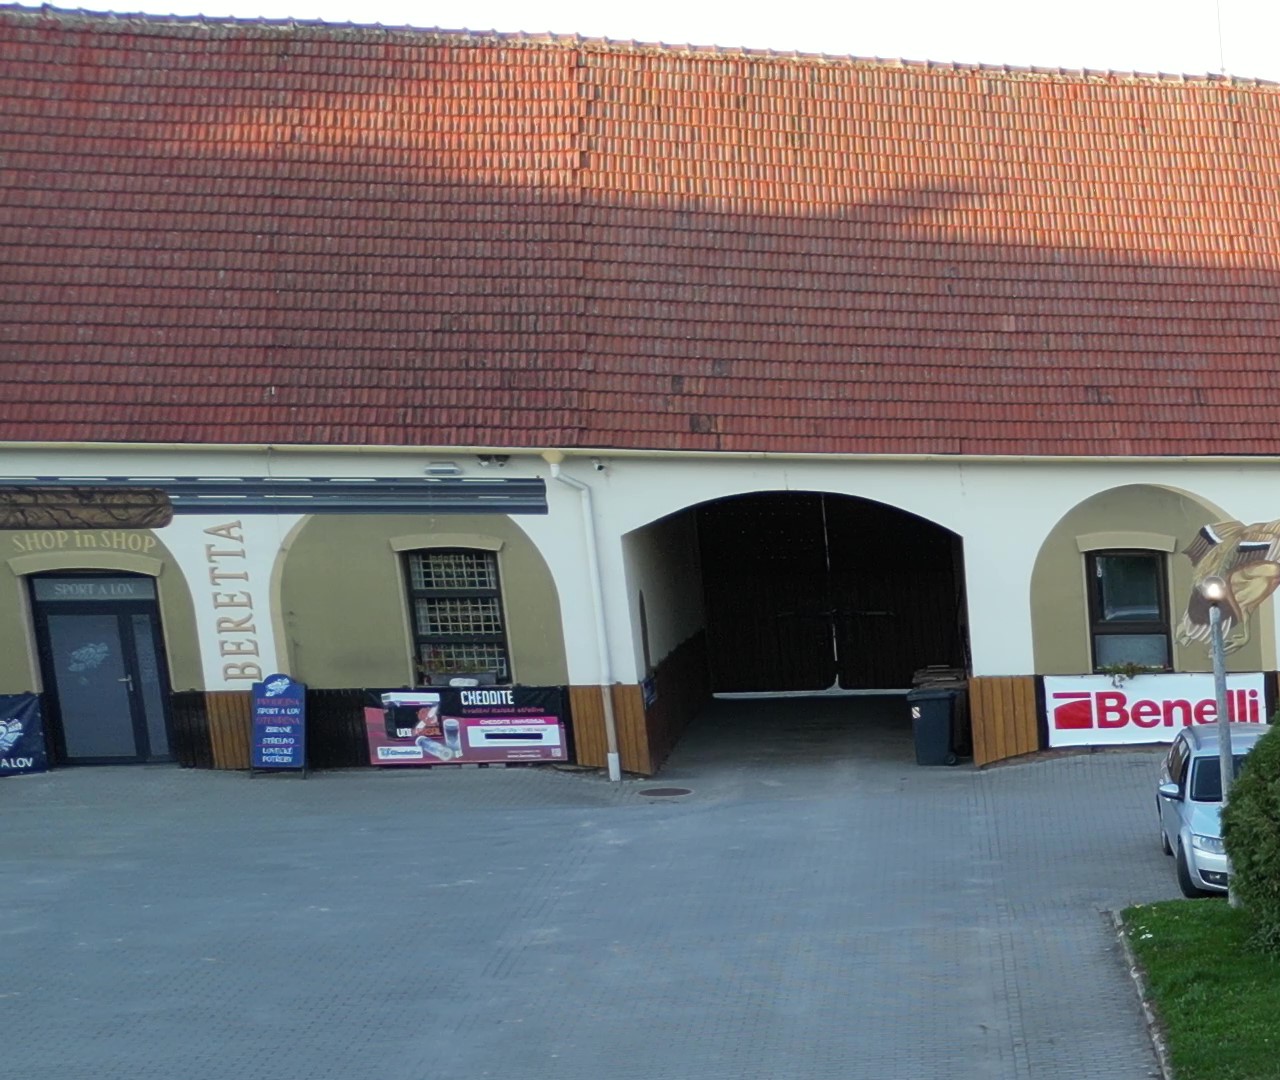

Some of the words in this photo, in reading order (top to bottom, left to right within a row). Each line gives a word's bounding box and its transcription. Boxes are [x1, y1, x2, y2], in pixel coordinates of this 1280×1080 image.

[12, 530, 69, 552] SHOP
[75, 530, 97, 548] in
[101, 531, 157, 553] SHOP
[54, 583, 94, 595] SPORT
[98, 584, 107, 595] A
[111, 583, 135, 595] LOV
[203, 520, 263, 682] BERETTA
[460, 690, 515, 706] CHEDDITE
[1095, 689, 1260, 728] Benelli
[10, 757, 34, 768] LOV
